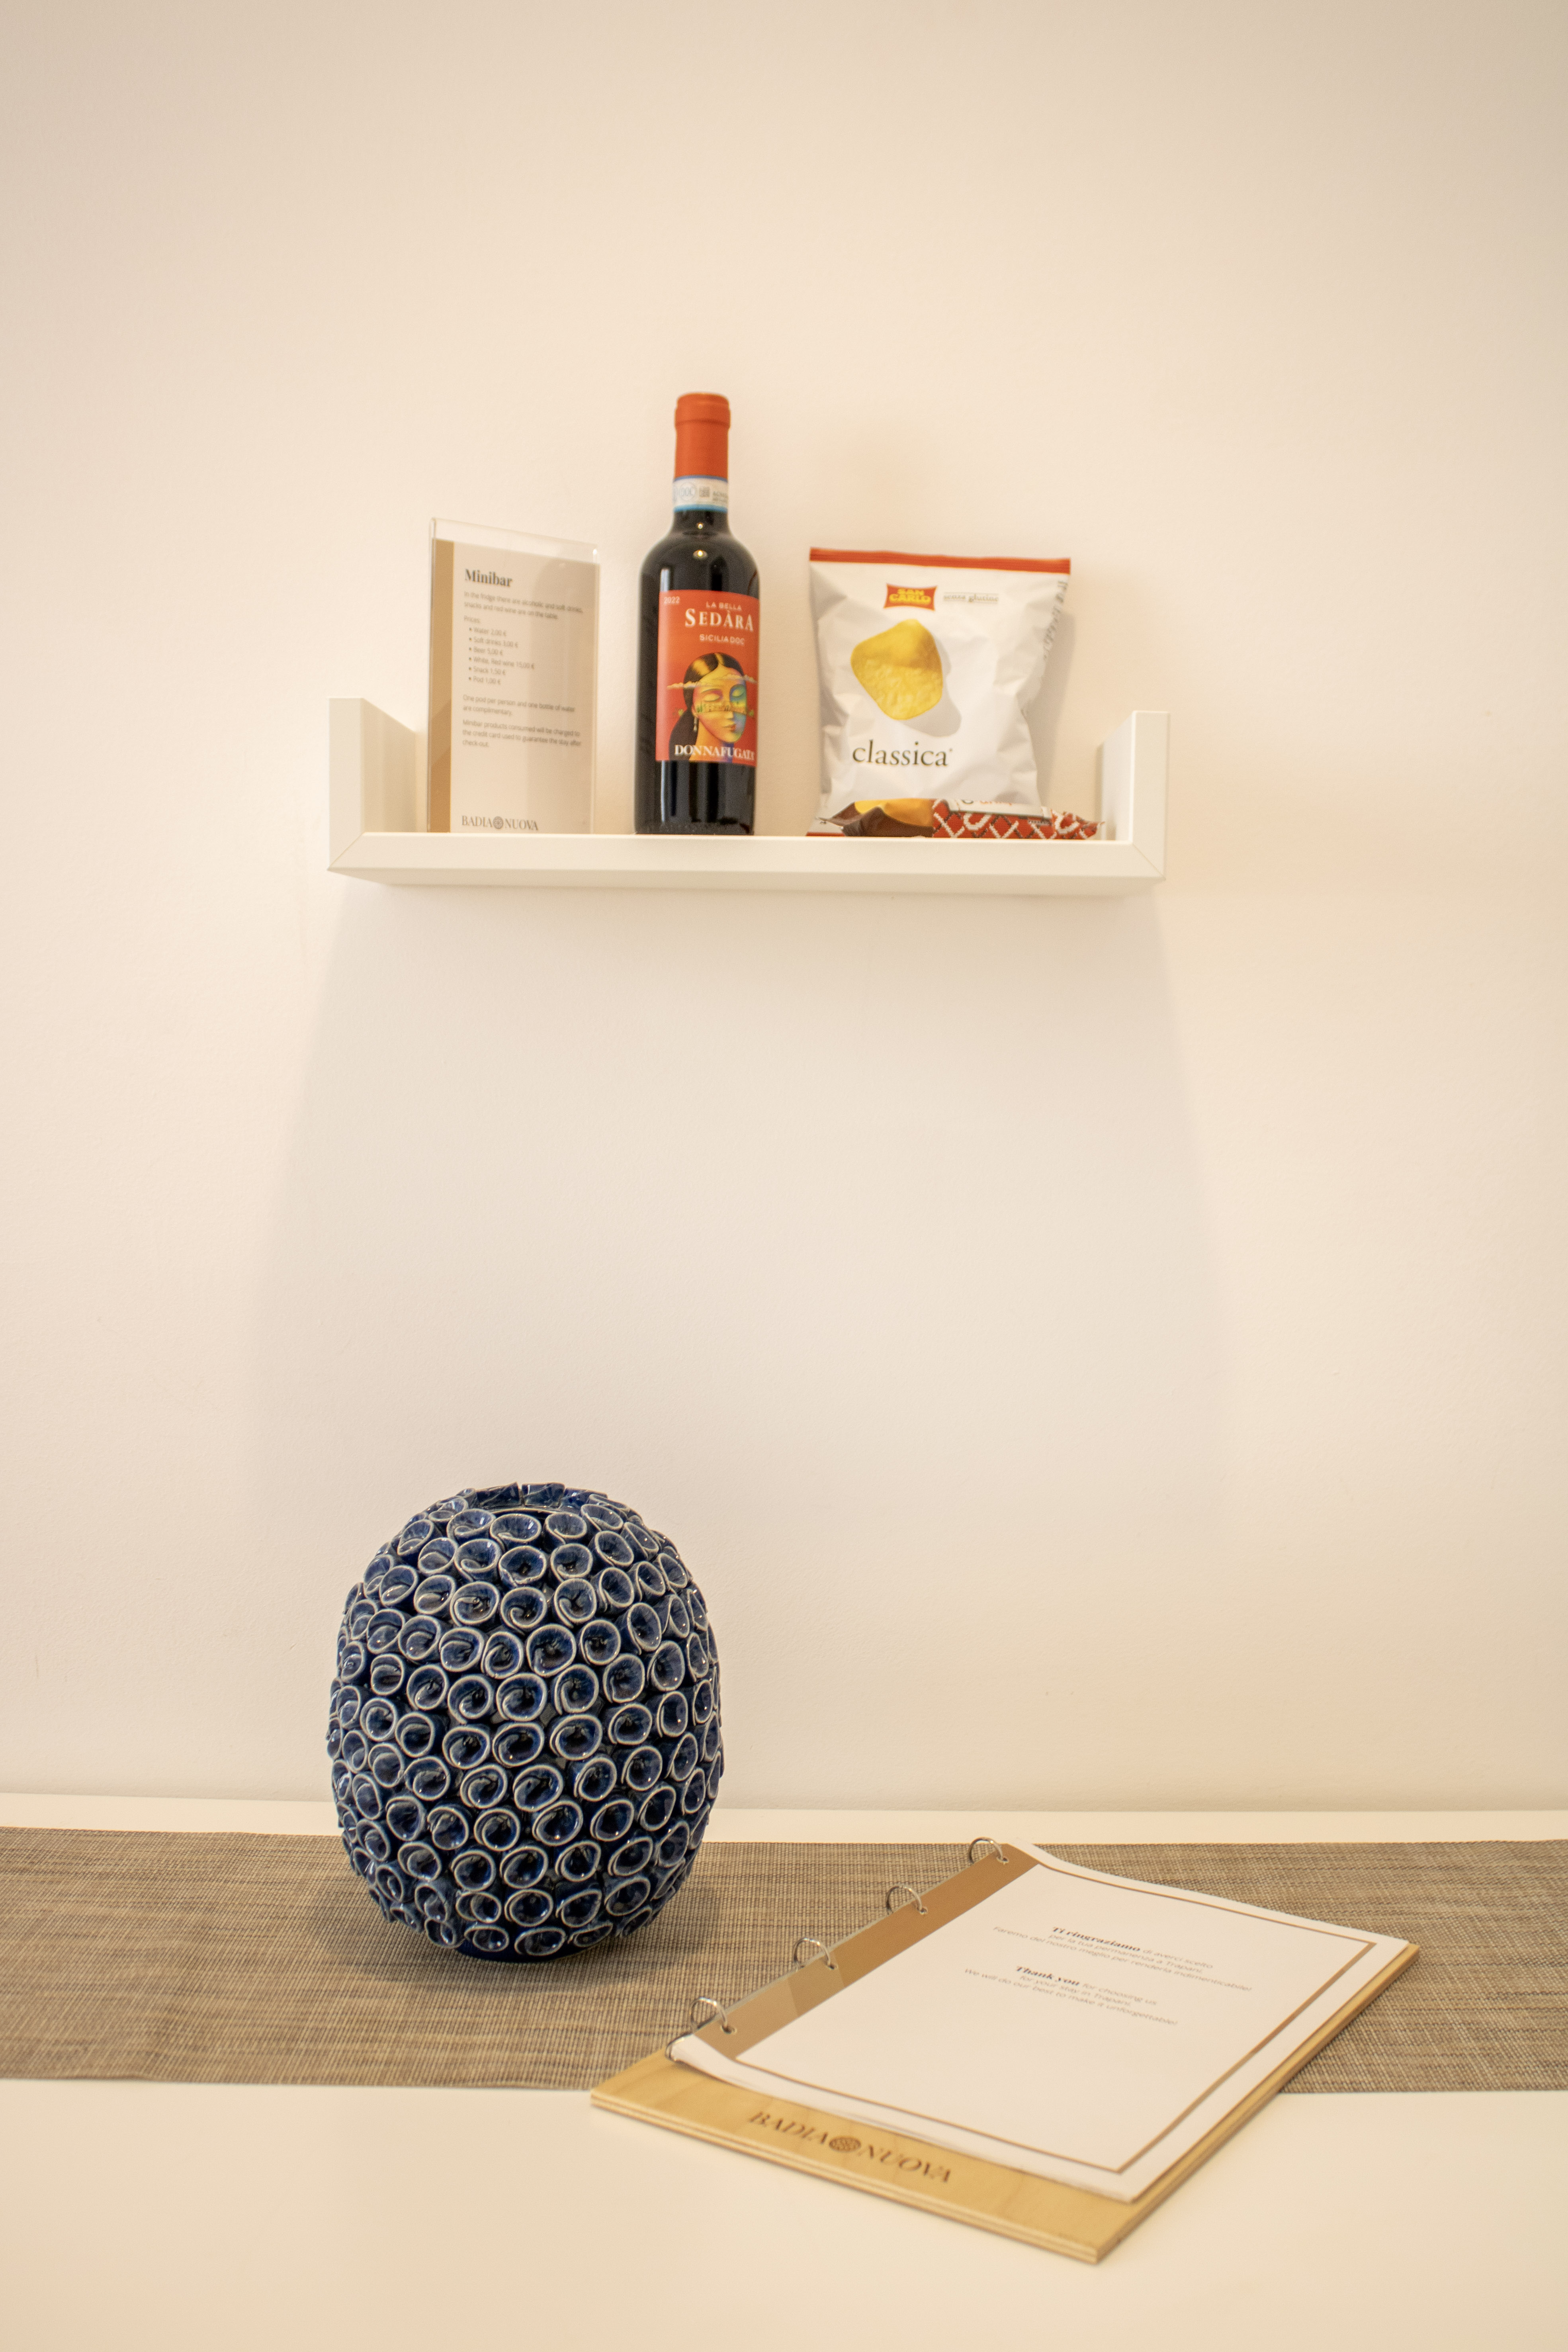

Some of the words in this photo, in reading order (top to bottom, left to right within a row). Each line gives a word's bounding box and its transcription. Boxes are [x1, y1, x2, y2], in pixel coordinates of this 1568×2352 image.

[465, 569, 512, 587] Minibar
[480, 593, 495, 602] fridge
[889, 593, 931, 605] CARLO
[968, 593, 999, 603] glutine
[719, 602, 742, 611] BELLA
[700, 634, 729, 643] SICILIA
[730, 637, 745, 646] DOC
[484, 722, 507, 730] products
[508, 724, 536, 732] consumed
[553, 728, 573, 737] charged
[852, 739, 948, 766] classica
[462, 815, 493, 828] BADIA
[505, 818, 538, 830] NUOVA
[993, 1927, 1028, 1939] Faremo
[1046, 1941, 1077, 1951] nostro
[1079, 1948, 1110, 1958] meglio
[1066, 1931, 1140, 1951] ringraziamo
[1154, 1952, 1182, 1961] averci
[1185, 1959, 1213, 1968] scelto
[1094, 1945, 1154, 1963] permanenza
[1017, 1966, 1054, 1979] Thank
[1054, 1977, 1080, 1986] you
[1099, 1988, 1143, 2002] choosing
[1060, 1985, 1080, 1994] stay
[1032, 1986, 1054, 1995] best
[1068, 1995, 1095, 2005] make
[750, 2111, 828, 2145] BADIA
[858, 2145, 951, 2183] NUOVA
